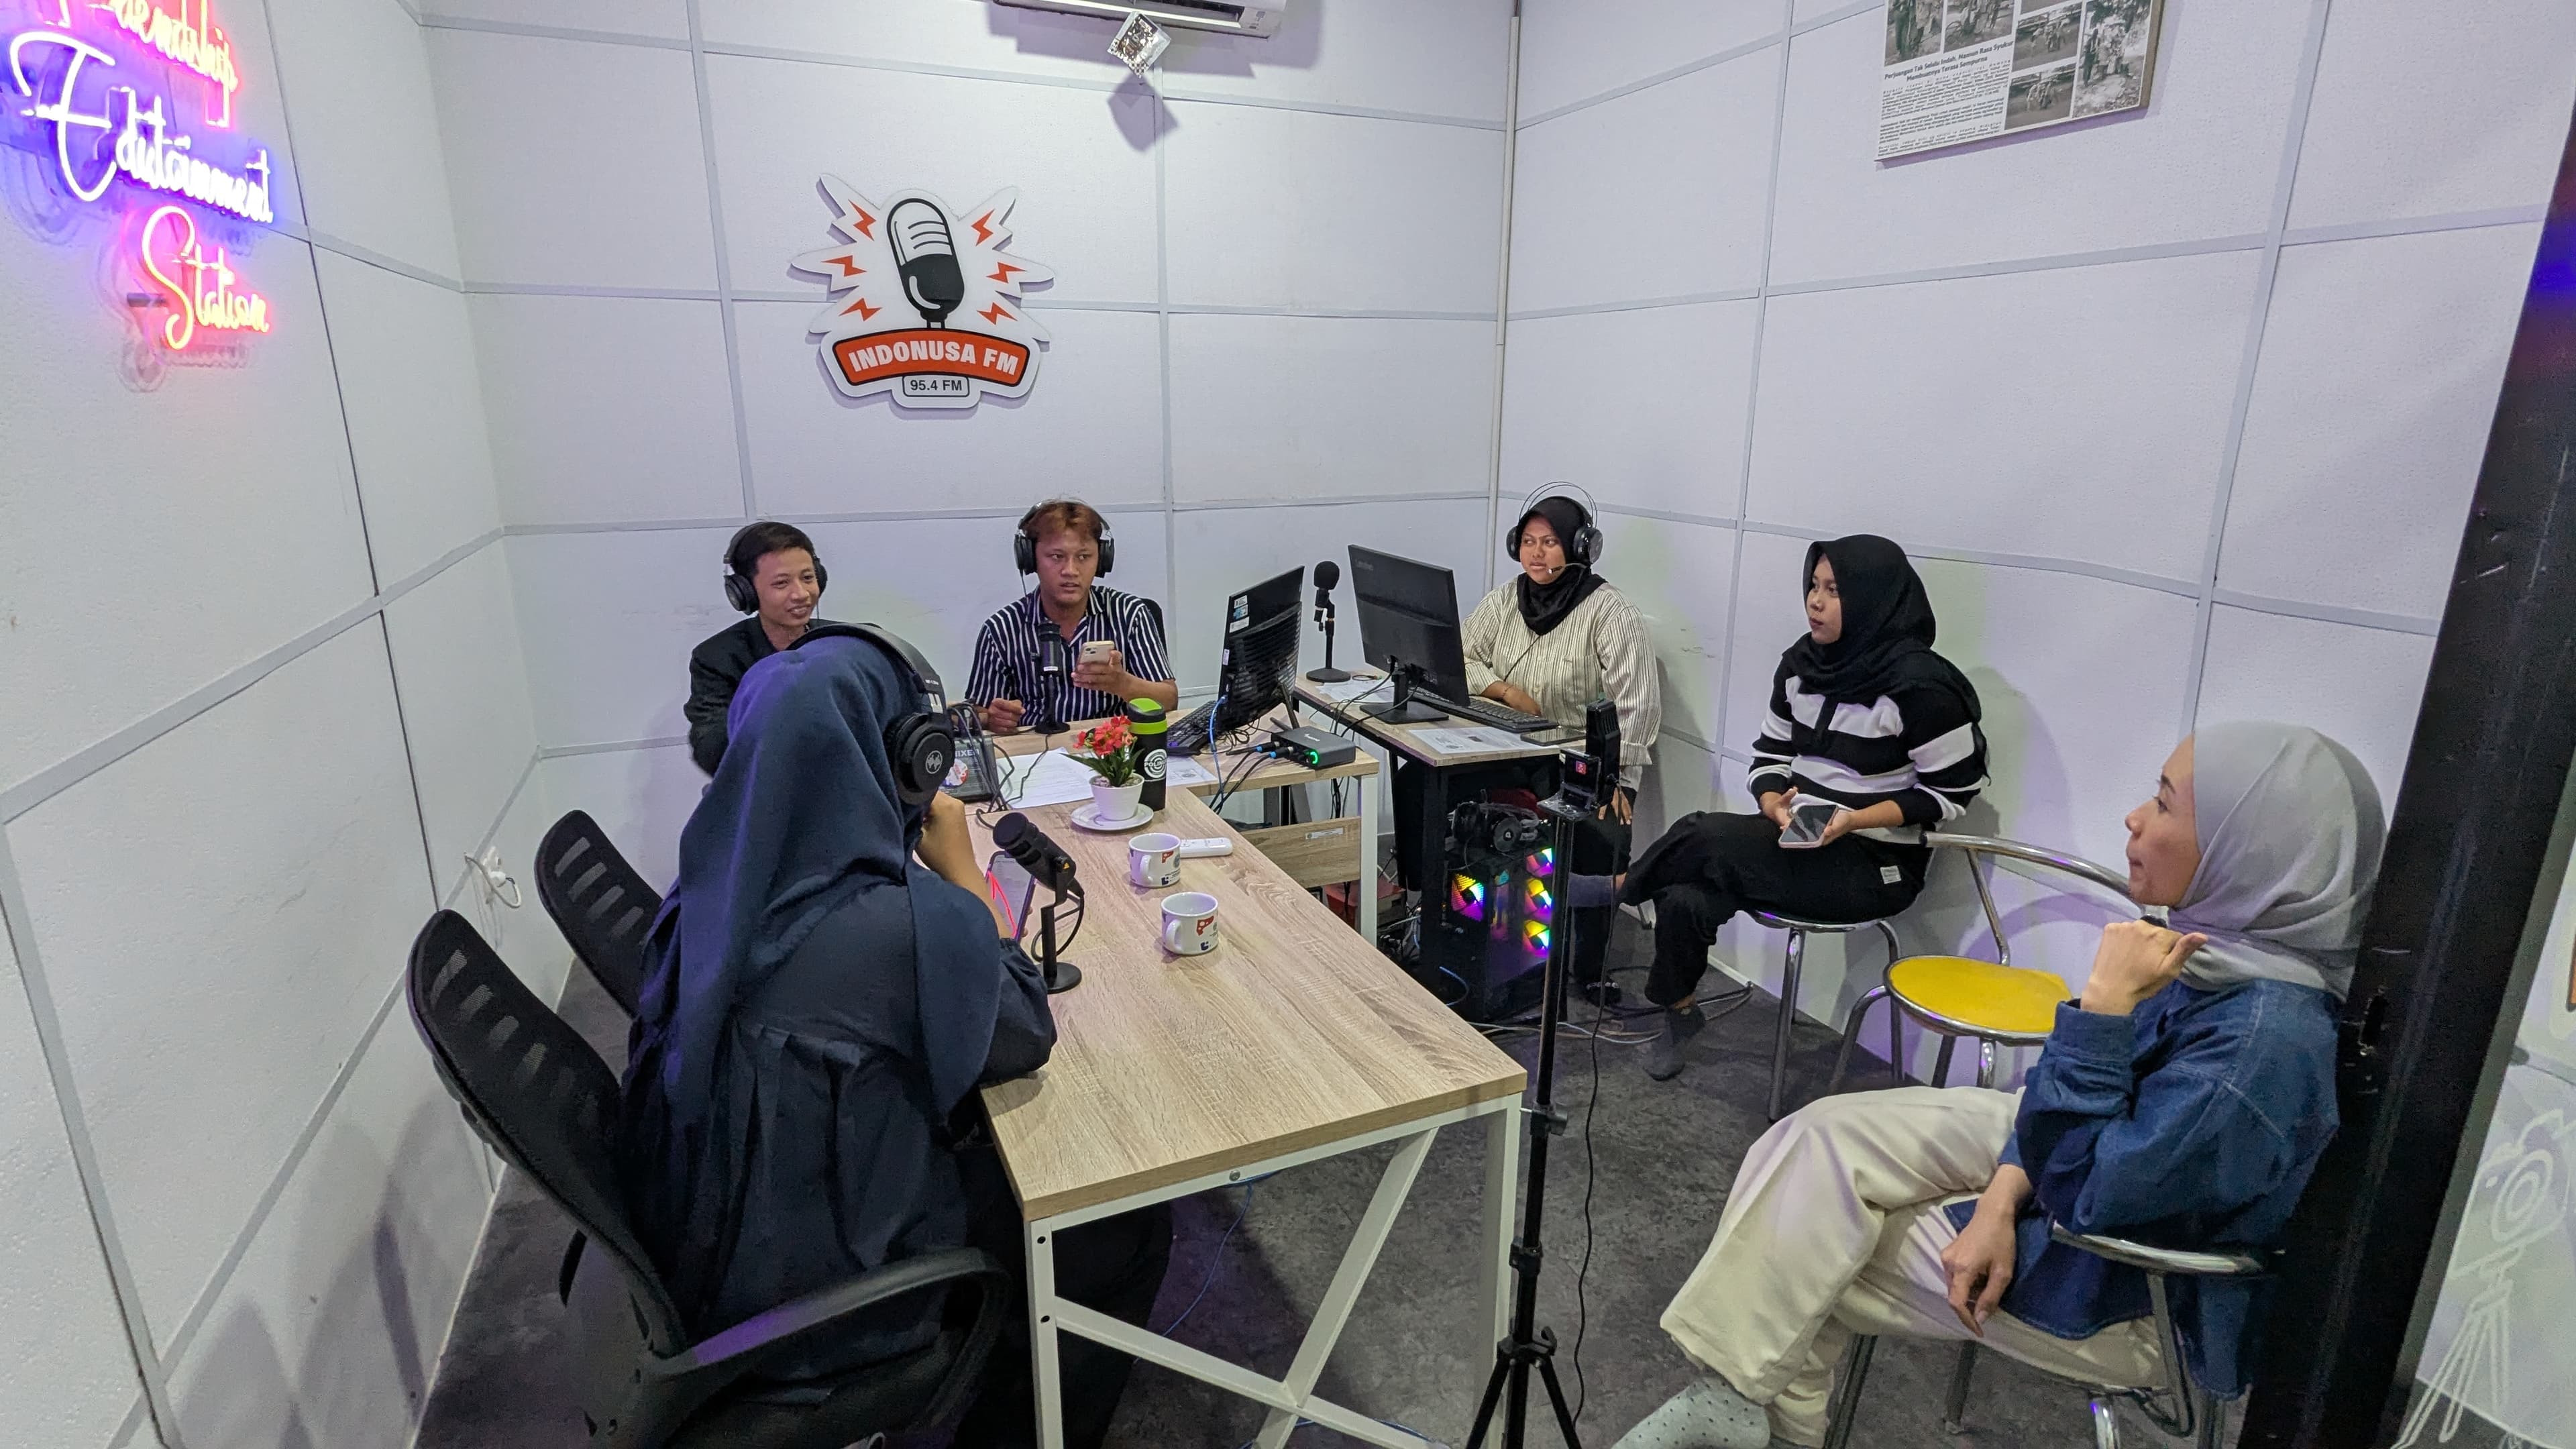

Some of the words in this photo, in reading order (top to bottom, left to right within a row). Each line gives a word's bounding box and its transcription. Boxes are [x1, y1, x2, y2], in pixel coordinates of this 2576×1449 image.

[1884, 68, 1913, 80] Perjuangan
[1924, 60, 1941, 70] Selalu
[1958, 50, 1978, 60] Namun
[1980, 46, 1992, 54] Rasa
[1993, 40, 2014, 51] Syukur
[1907, 69, 1941, 81] Membuatnya
[1941, 64, 1958, 72] Terasa
[1960, 56, 1988, 68] Sempurna
[9, 31, 274, 223] Edutainment
[142, 205, 270, 350] Station
[848, 340, 976, 372] INDONUSA
[983, 347, 1019, 375] FM
[910, 379, 938, 391] 95.4
[943, 380, 962, 391] FM
